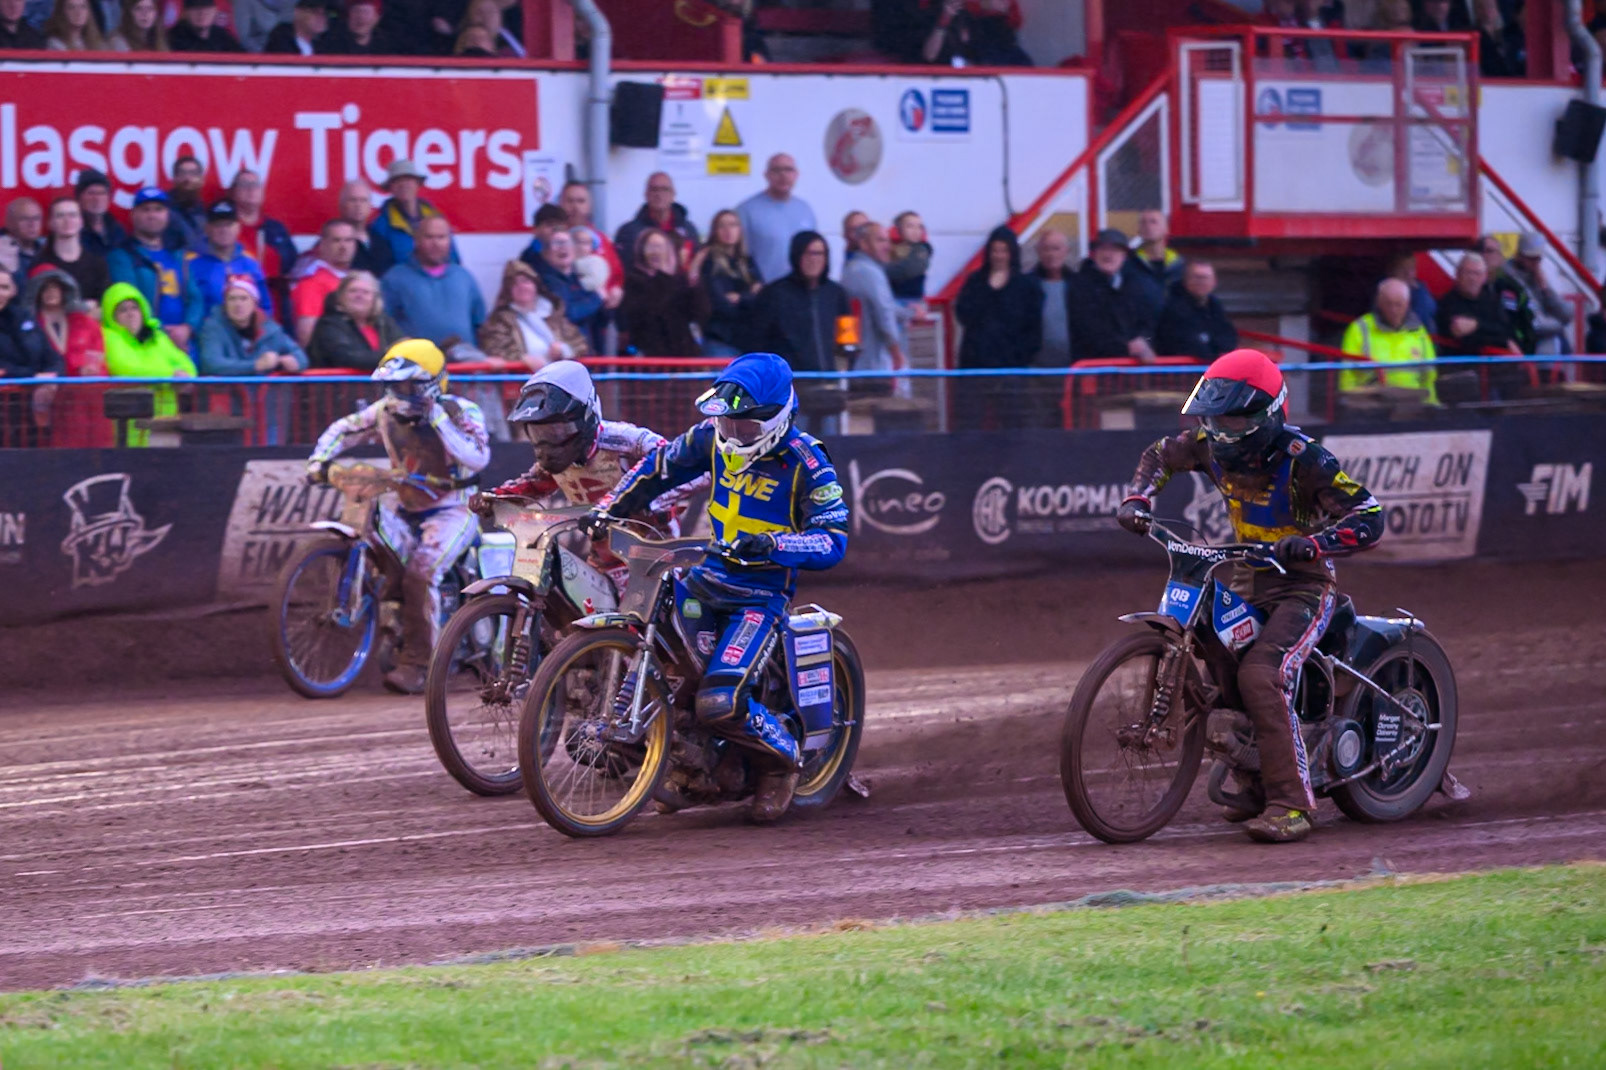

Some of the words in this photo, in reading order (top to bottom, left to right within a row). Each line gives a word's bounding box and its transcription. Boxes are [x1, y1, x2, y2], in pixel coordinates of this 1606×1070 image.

[294, 103, 522, 208] Tigers
[719, 469, 779, 502] SWE
[1434, 452, 1474, 488] ON
[1516, 462, 1592, 515] FIM
[256, 484, 344, 523] WATC
